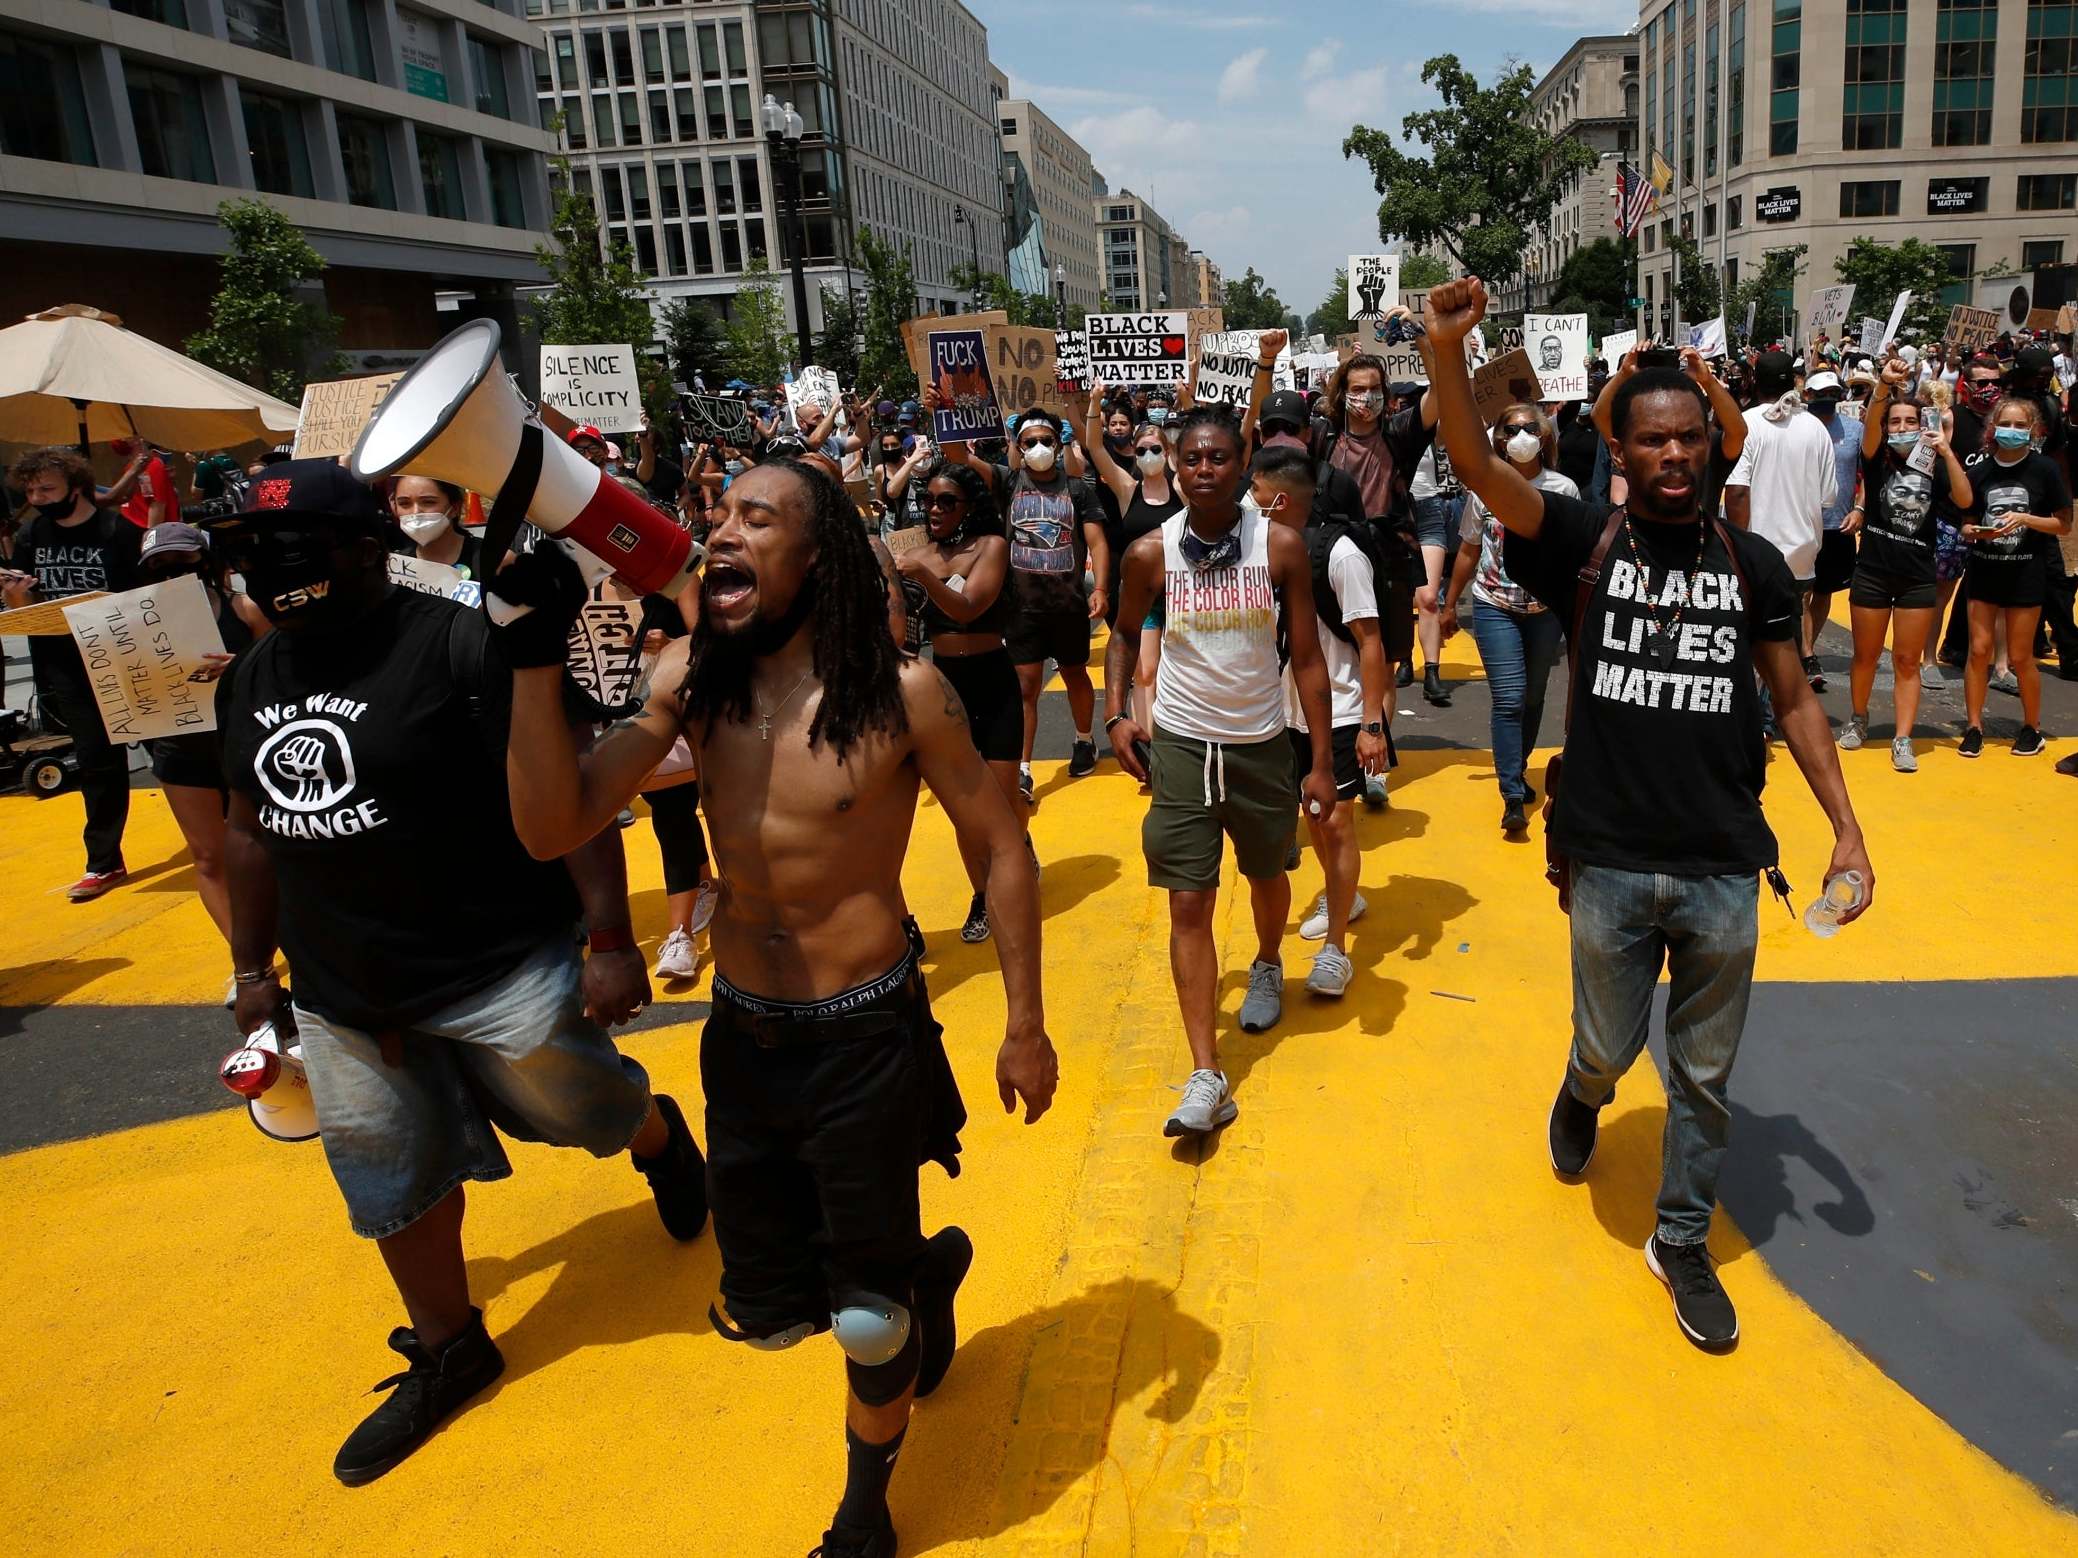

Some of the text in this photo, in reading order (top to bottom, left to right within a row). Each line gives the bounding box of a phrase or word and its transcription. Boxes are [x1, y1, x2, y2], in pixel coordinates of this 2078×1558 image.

[1758, 199, 1799, 210] BLACK LIVES
[1764, 206, 1791, 216] MATTER
[1937, 199, 1965, 207] MATTER
[1356, 266, 1392, 275] PEOPLE
[1360, 257, 1380, 266] THE
[1089, 315, 1170, 335] BLACK
[1188, 311, 1217, 325] ACK
[1529, 317, 1583, 332] I CAN'T
[1963, 308, 1999, 330] JUSTICE
[1055, 332, 1069, 344] We
[1091, 338, 1162, 358] LIVES
[936, 340, 978, 366] FUCK
[999, 337, 1045, 370] NO
[545, 355, 621, 377] SILENCE
[1092, 363, 1186, 381] MATTER
[1201, 353, 1259, 379] NO JUSTIC
[307, 380, 367, 402] JUSTICE
[568, 378, 582, 390] IS
[998, 374, 1037, 410] NO
[1197, 381, 1252, 406] NO PEAC
[1538, 376, 1584, 394] REATHE
[304, 398, 364, 419] JUSTICE
[542, 390, 629, 407] COMPLICITY
[937, 406, 1000, 432] TRUMP
[35, 546, 104, 564] BLACK
[1165, 565, 1271, 590] THE COLOR RUN
[1607, 558, 1744, 611] BLACK
[1165, 586, 1272, 613] THE COLOR RUN
[105, 606, 162, 716] MATTER UNTIL
[153, 631, 184, 679] LIVES
[76, 623, 142, 735] ALL LIVES DONT
[1592, 660, 1733, 713] MATTER
[167, 680, 204, 727] BLACK
[254, 692, 368, 729] We Want
[259, 798, 388, 839] CHANGE
